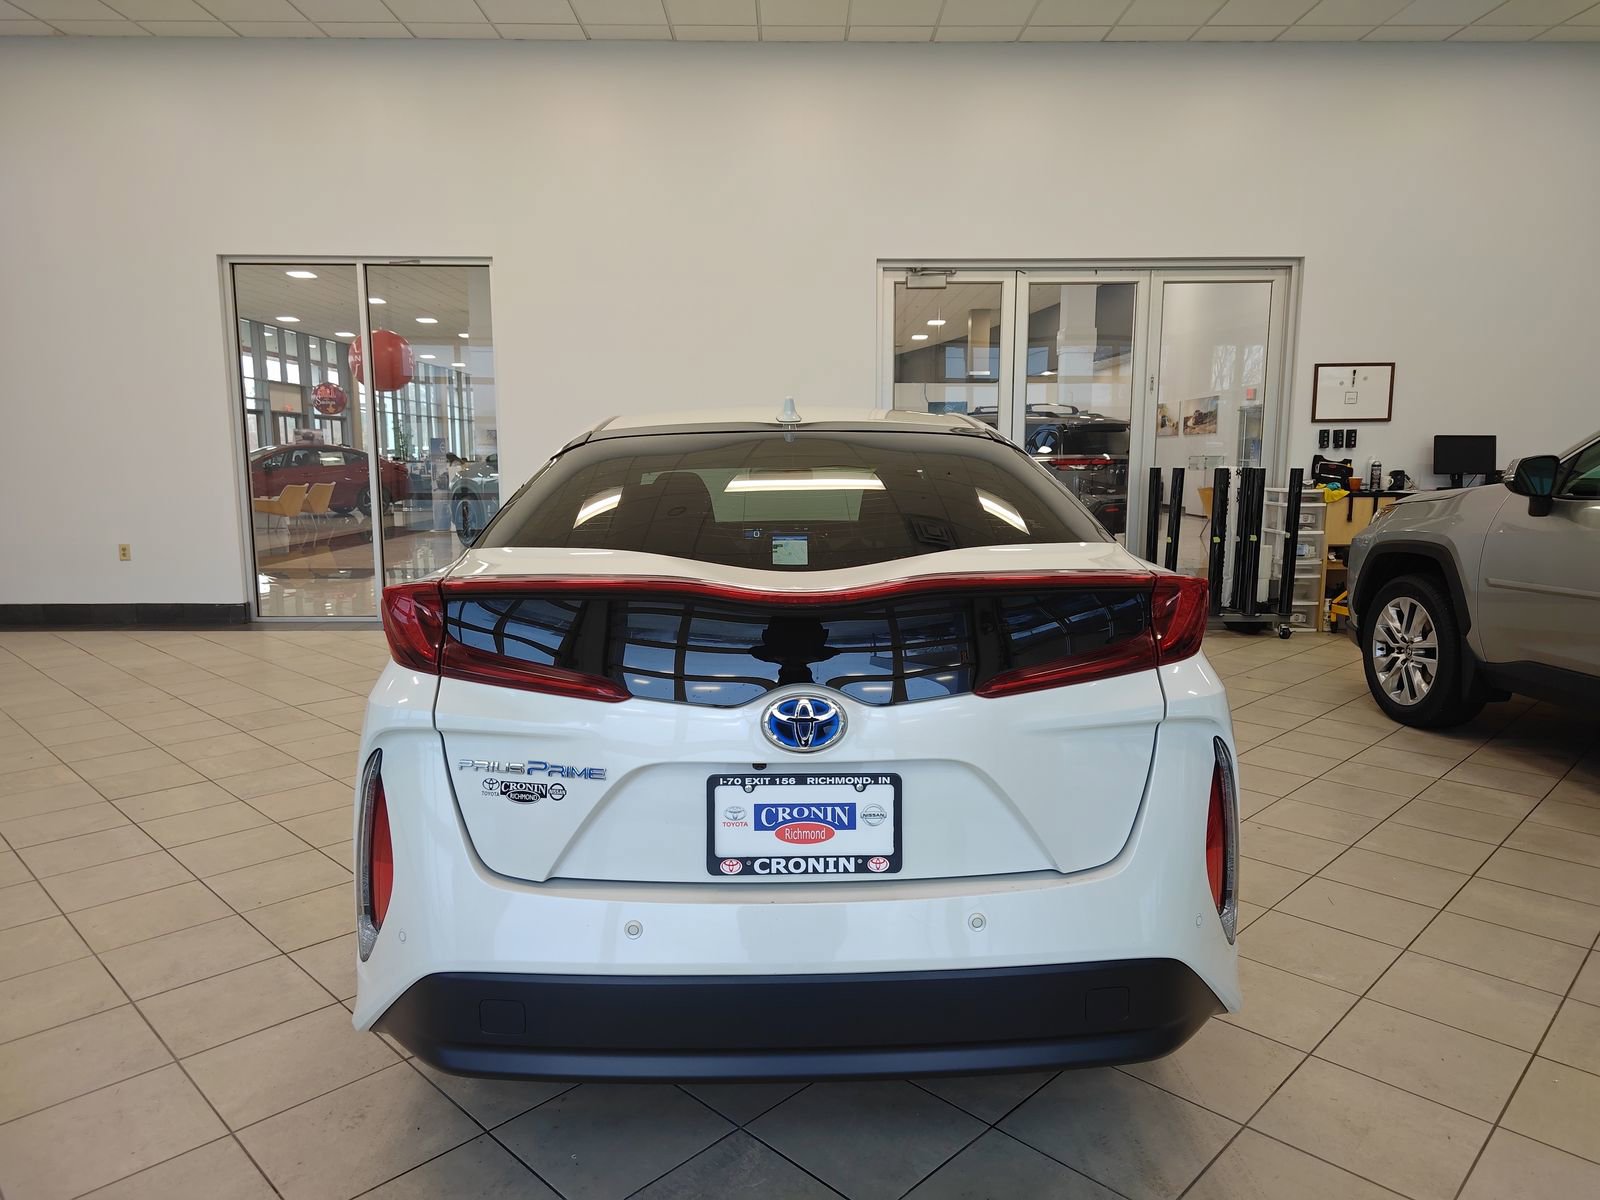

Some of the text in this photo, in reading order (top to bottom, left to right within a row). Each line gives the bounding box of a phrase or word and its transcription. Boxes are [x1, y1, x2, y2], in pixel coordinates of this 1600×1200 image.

[458, 759, 607, 781] PRIUS PRIME
[719, 777, 742, 785] I-70
[745, 777, 771, 785] EXIT
[775, 777, 796, 785] 156
[878, 776, 891, 784] IN
[501, 781, 547, 798] CRONIN
[510, 792, 538, 801] RICHMOND
[760, 806, 849, 827] CRONIN
[784, 828, 826, 841] Richmond
[753, 857, 856, 874] CRONIN
